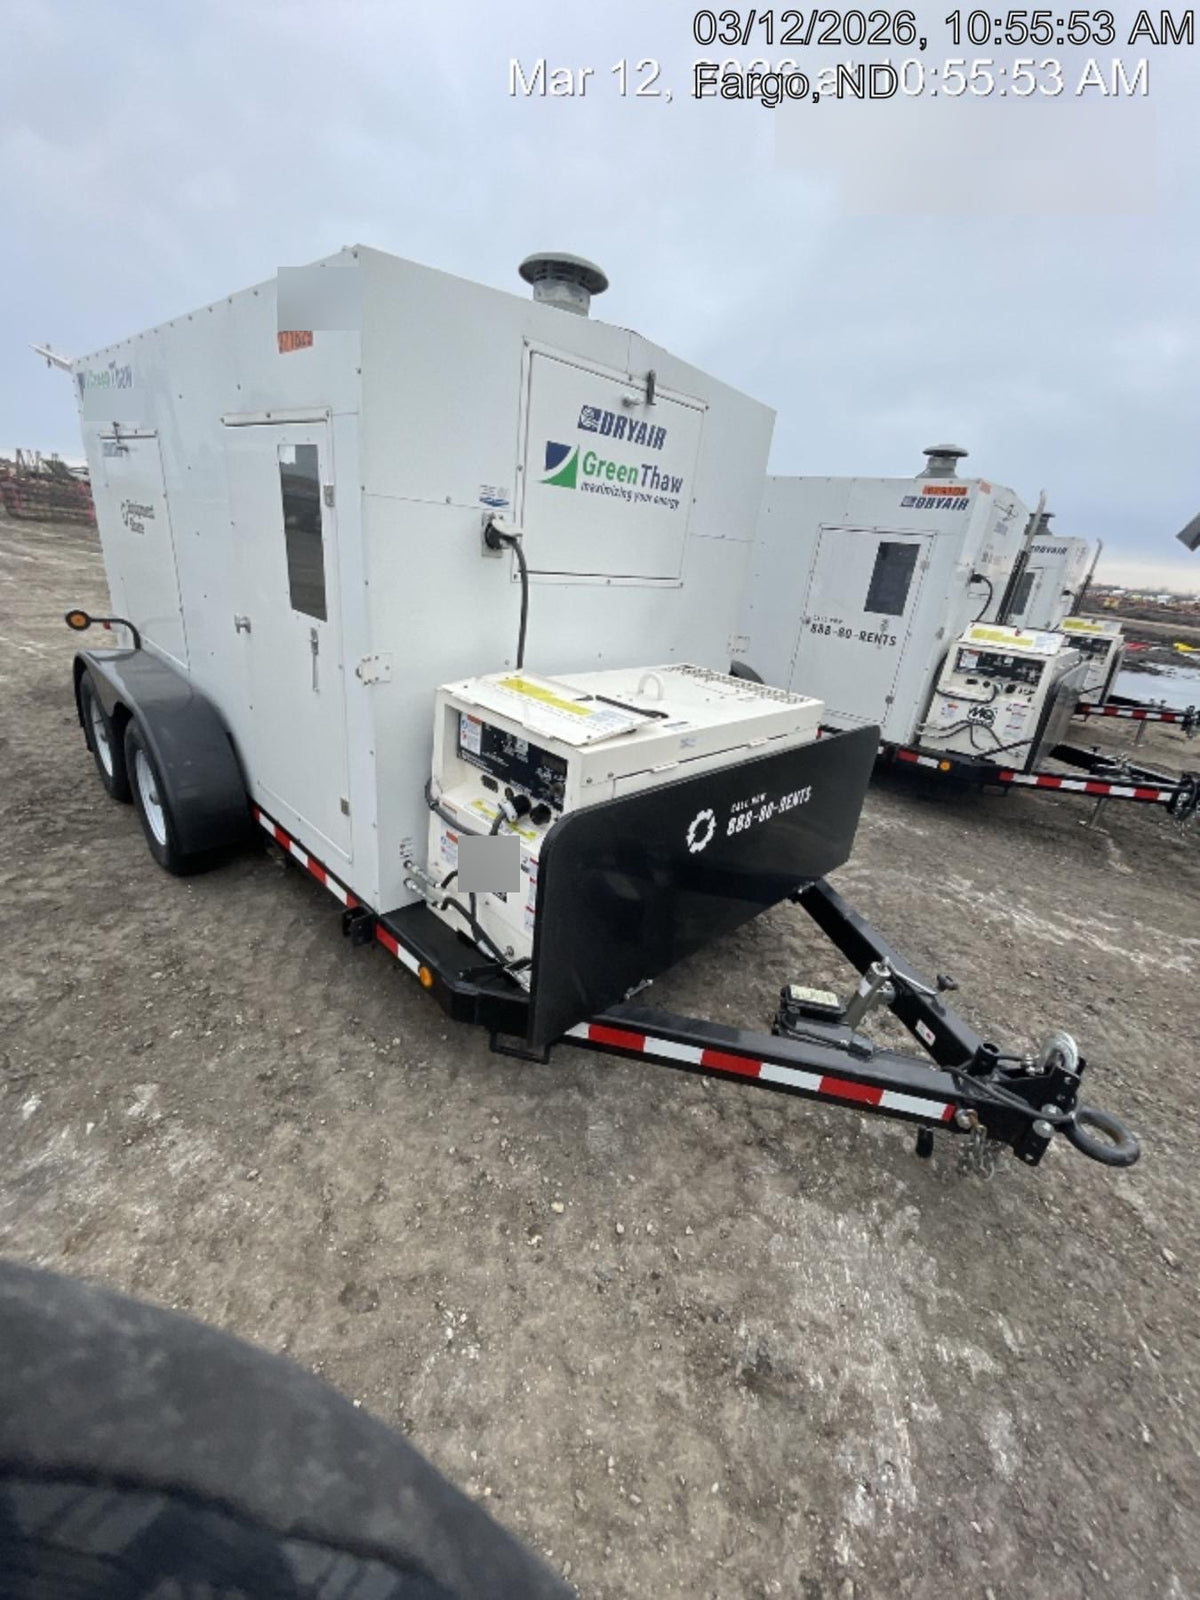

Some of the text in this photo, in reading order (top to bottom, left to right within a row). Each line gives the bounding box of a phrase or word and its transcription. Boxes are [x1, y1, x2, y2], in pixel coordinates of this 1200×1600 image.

[600, 409, 668, 451] DRYAIR
[582, 450, 684, 494] GreenThaw
[727, 785, 812, 836] 888-80-RENTS
